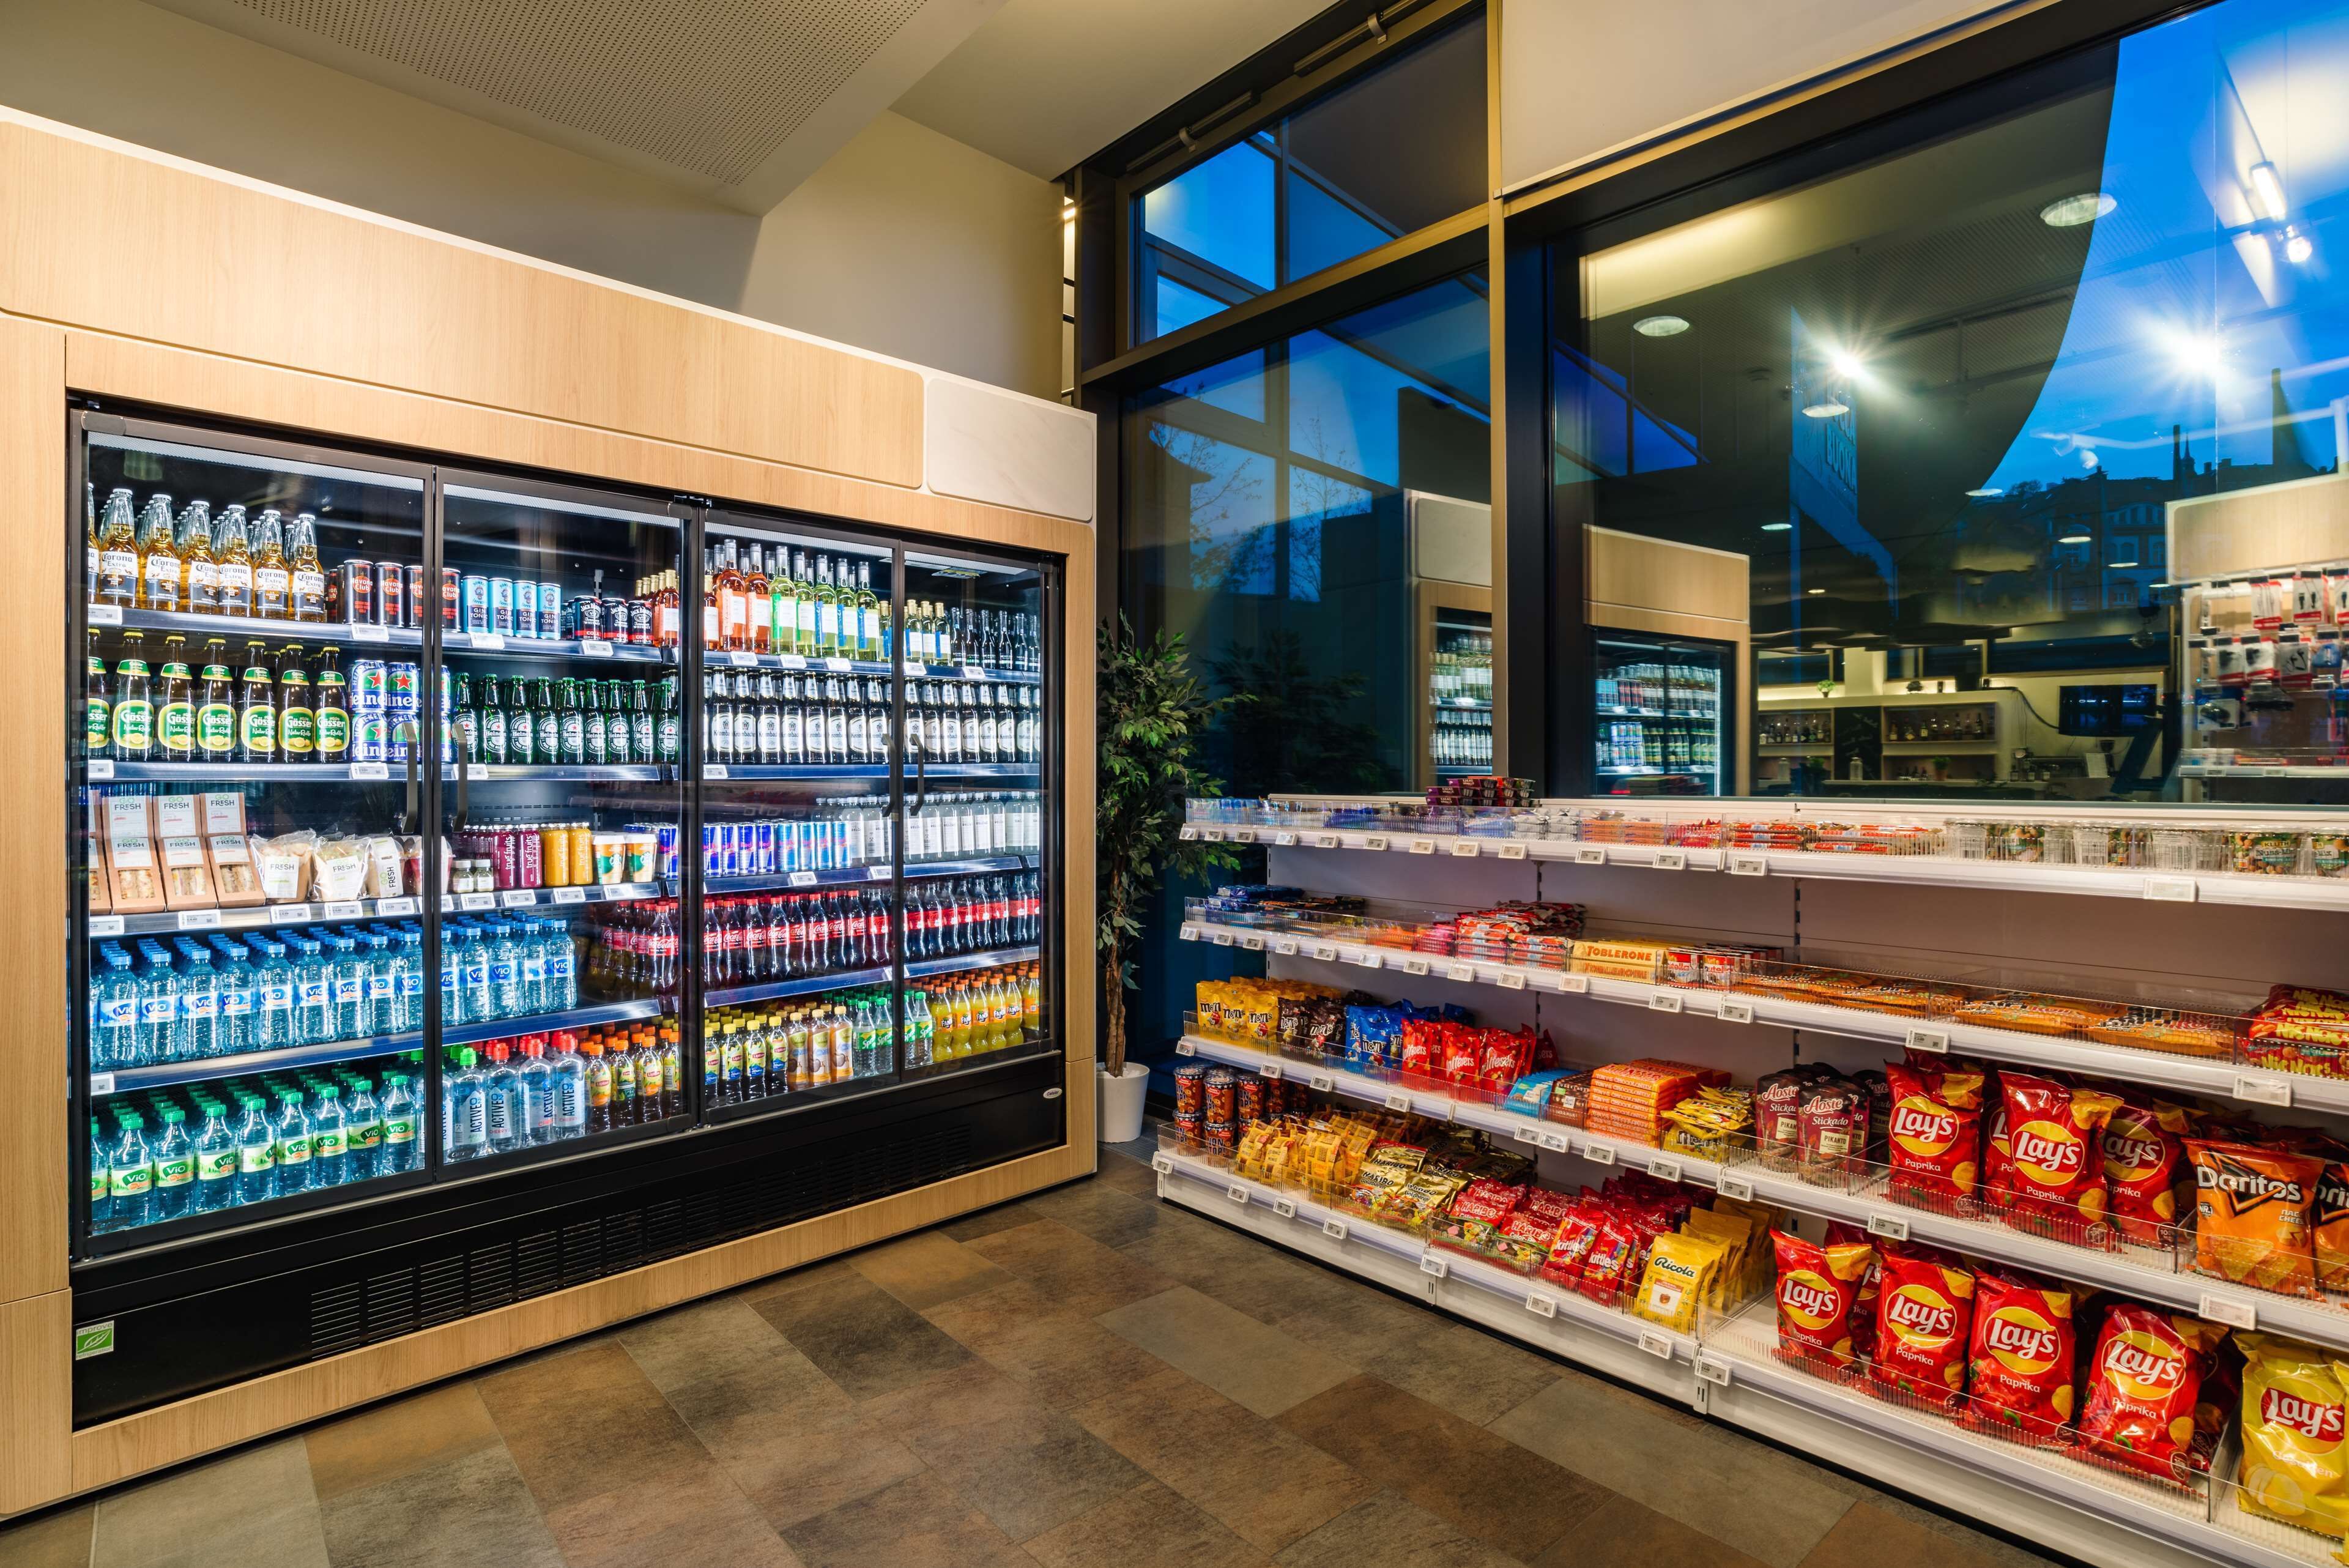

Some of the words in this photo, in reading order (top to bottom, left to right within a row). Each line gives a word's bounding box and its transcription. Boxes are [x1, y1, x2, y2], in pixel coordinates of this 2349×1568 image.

[103, 553, 133, 562] Corona
[121, 710, 153, 723] Gösser
[286, 715, 312, 727] Gösser
[1587, 946, 1652, 961] TOBLERONE
[1762, 1083, 1799, 1101] Aoste
[562, 1089, 575, 1117] ACTIVE
[1770, 1103, 1797, 1112] Sticka
[1803, 1096, 1844, 1115] Aoste
[470, 1104, 482, 1132] ACTIVE
[492, 1101, 504, 1128] ACTIVE
[1812, 1117, 1849, 1126] Stickado
[1893, 1107, 1954, 1142] Lay's
[1824, 1135, 1846, 1145] PIKANTO
[2015, 1131, 2080, 1172] Lay's
[1373, 1158, 1407, 1169] HARIBO
[1905, 1157, 1941, 1172] Paprika
[1362, 1172, 1394, 1186] HARIBO
[2197, 1166, 2303, 1202] Doritos
[2026, 1186, 2065, 1203] Paprika
[2106, 1184, 2142, 1198] aprika
[1461, 1202, 1496, 1217] HARIBO
[1511, 1220, 1551, 1241] HARIBO
[1555, 1239, 1587, 1255] kittles
[1589, 1252, 1618, 1271] kittles
[1653, 1256, 1696, 1278] Ricola
[1783, 1279, 1836, 1317] Lay's
[1888, 1295, 1953, 1335] Lay's
[77, 1322, 113, 1336] improve
[1989, 1319, 2057, 1359] Lay's
[1896, 1347, 1934, 1366] Paprika
[2105, 1340, 2181, 1385] Lay's
[1999, 1374, 2041, 1393] Paprika
[2112, 1397, 2157, 1419] Paprika
[2266, 1387, 2343, 1438] Lay's
